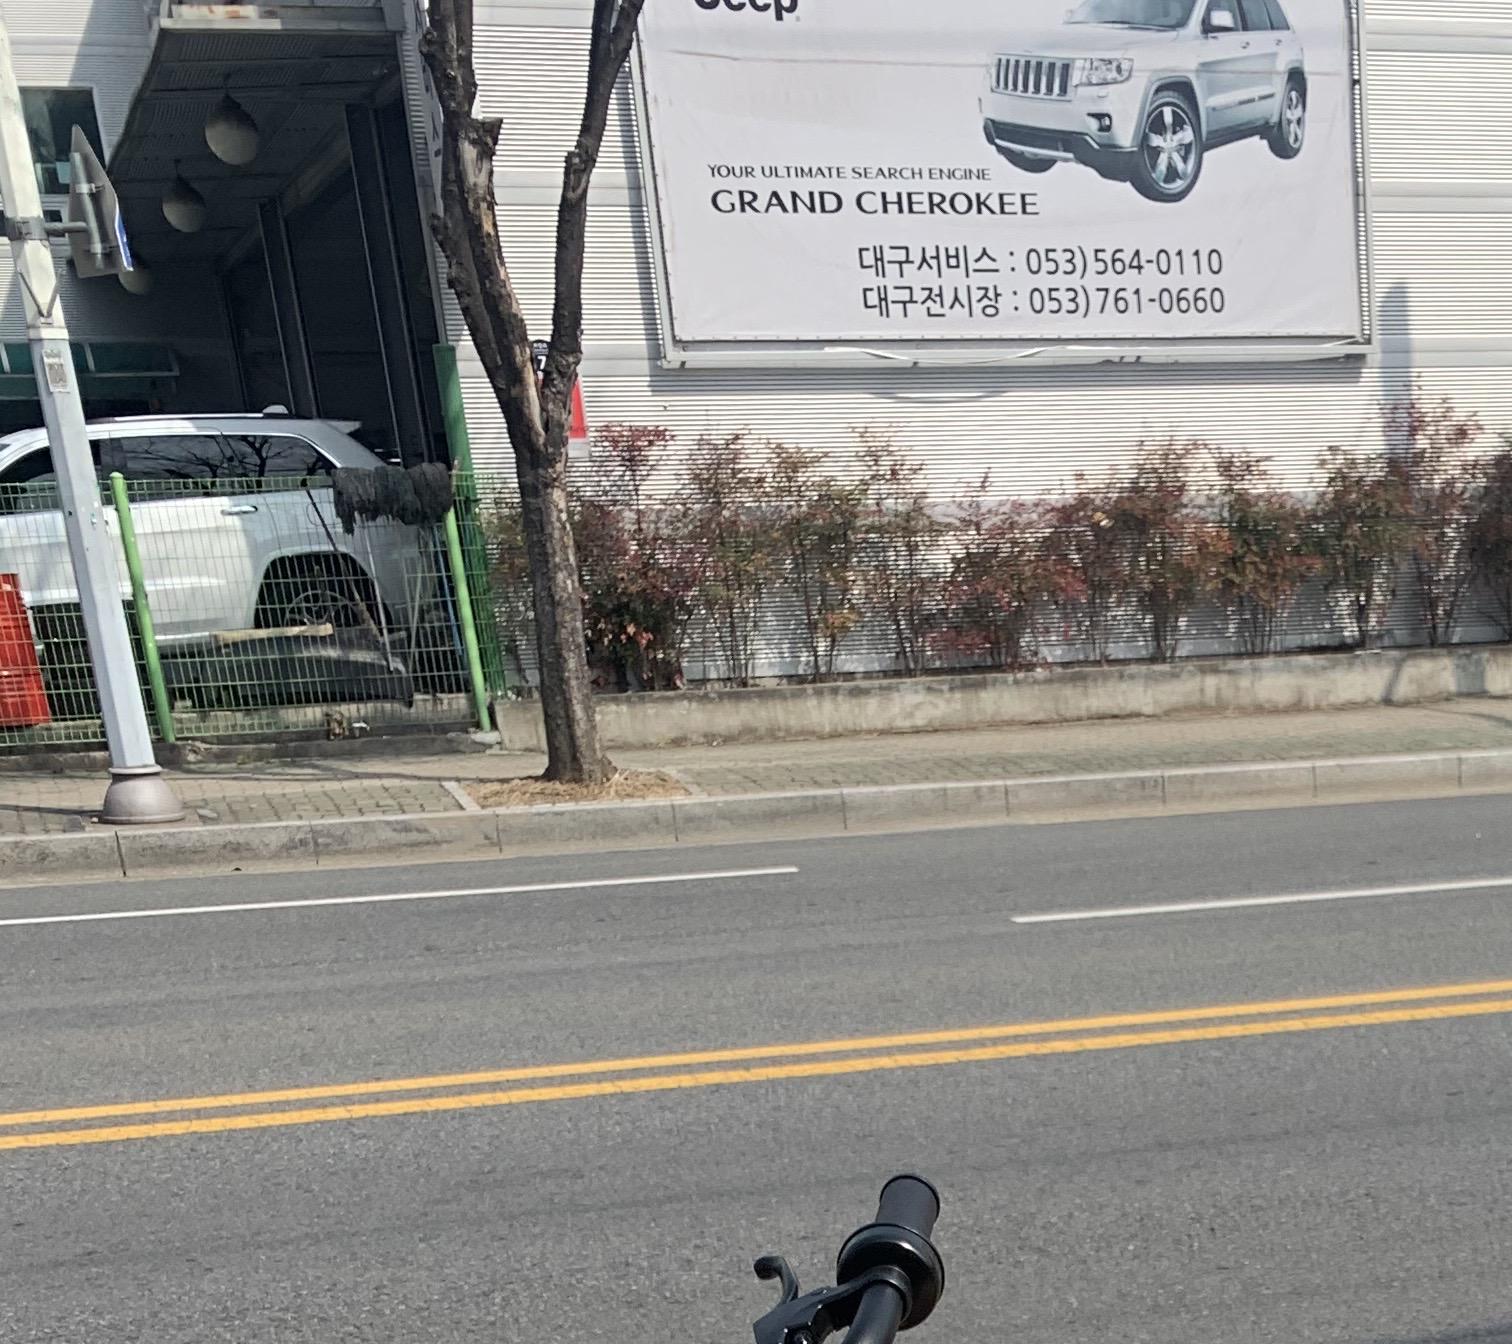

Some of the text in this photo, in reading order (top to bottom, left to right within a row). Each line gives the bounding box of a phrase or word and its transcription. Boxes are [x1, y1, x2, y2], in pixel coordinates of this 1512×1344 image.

[707, 164, 991, 181] YOUR ULTIMATE SEARCH ENGINE
[710, 189, 1040, 215] GRAND CHEROKEE
[858, 245, 1000, 279] 대구서비스
[1026, 247, 1223, 280] 053)564-0110
[862, 284, 1003, 318] 대구전시장
[1029, 286, 1225, 318] 053)761-0660
